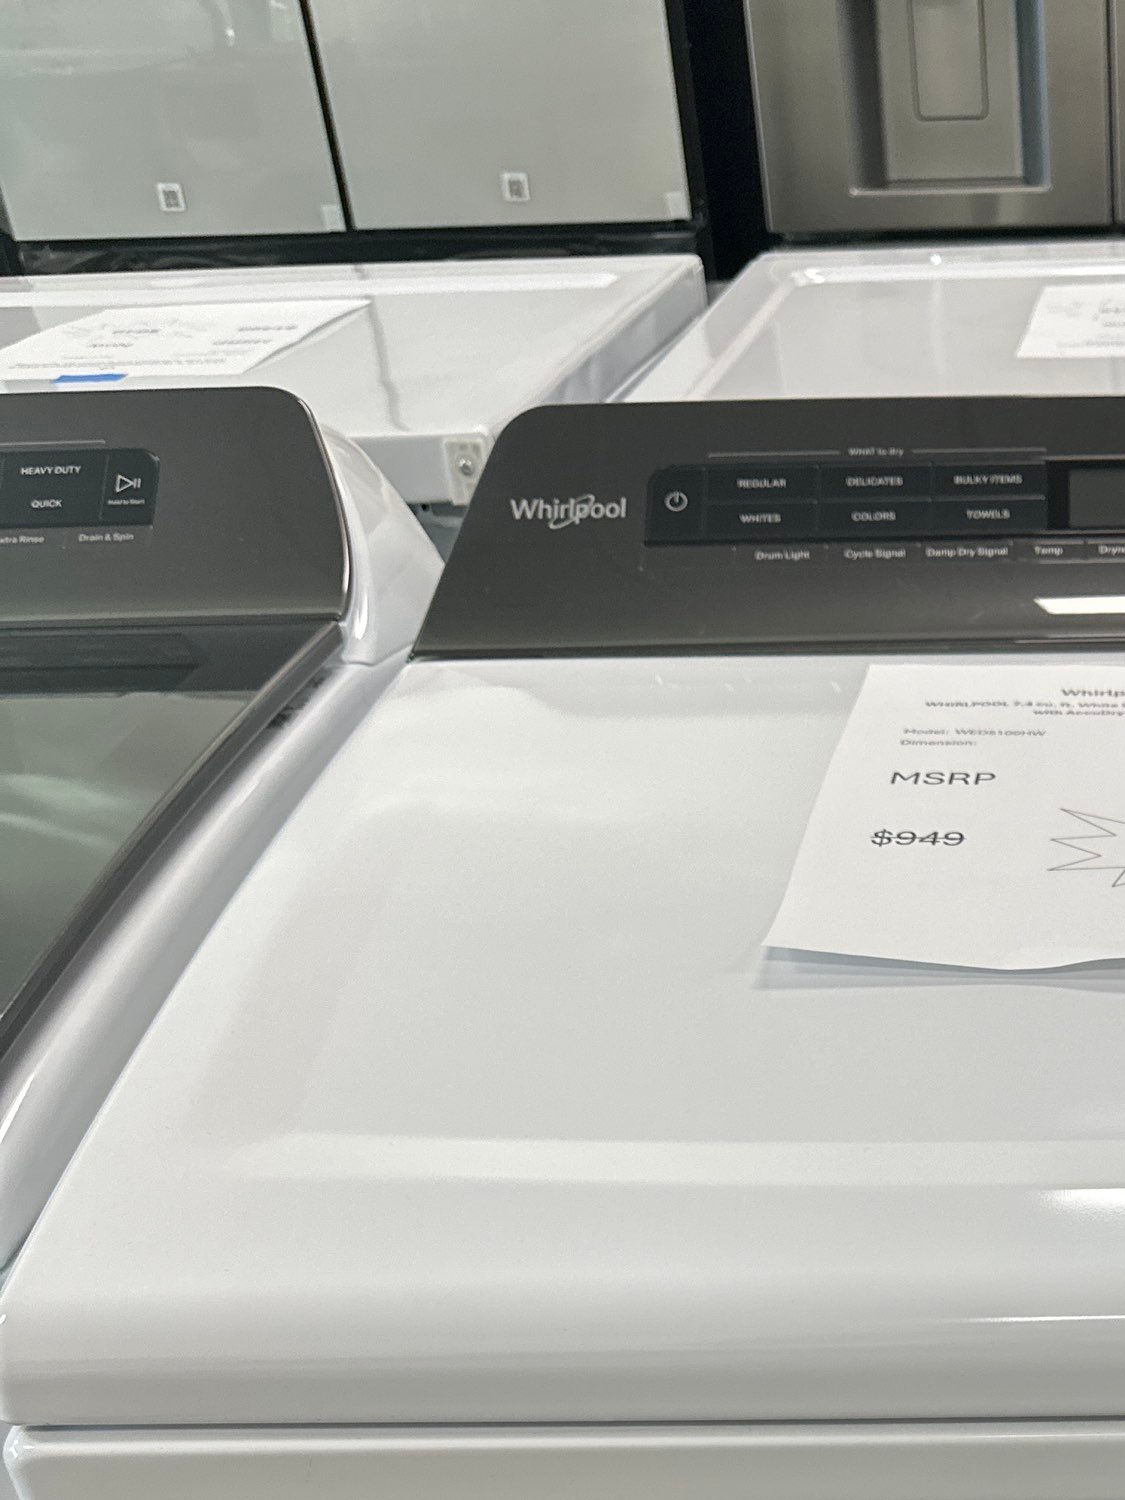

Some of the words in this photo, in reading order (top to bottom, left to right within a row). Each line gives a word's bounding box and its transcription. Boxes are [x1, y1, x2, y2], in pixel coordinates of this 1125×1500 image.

[21, 466, 51, 476] HEAVY
[54, 465, 81, 474] DUTY
[736, 477, 787, 489] REGULAR
[846, 476, 903, 488] DELICATES
[953, 474, 990, 486] BULKY
[991, 474, 1023, 485] ITEMS
[30, 499, 63, 508] QUICK
[510, 494, 627, 529] Whirlpool
[851, 511, 896, 522] COLORS
[966, 509, 1011, 520] TOWELS
[738, 513, 782, 524] WHITES
[19, 535, 44, 544] Rinse
[78, 533, 103, 543] Drain
[105, 533, 112, 542] &
[113, 532, 134, 543] Spin
[754, 550, 783, 561] Drum
[785, 550, 810, 562] Light
[844, 549, 873, 561] Cycle
[875, 548, 906, 560] Signal
[925, 547, 957, 559] Damp
[958, 547, 976, 559] Dry
[977, 546, 1009, 558] Signal
[1034, 546, 1064, 557] Temp
[890, 771, 996, 786] MSRP
[871, 828, 966, 848] $949
